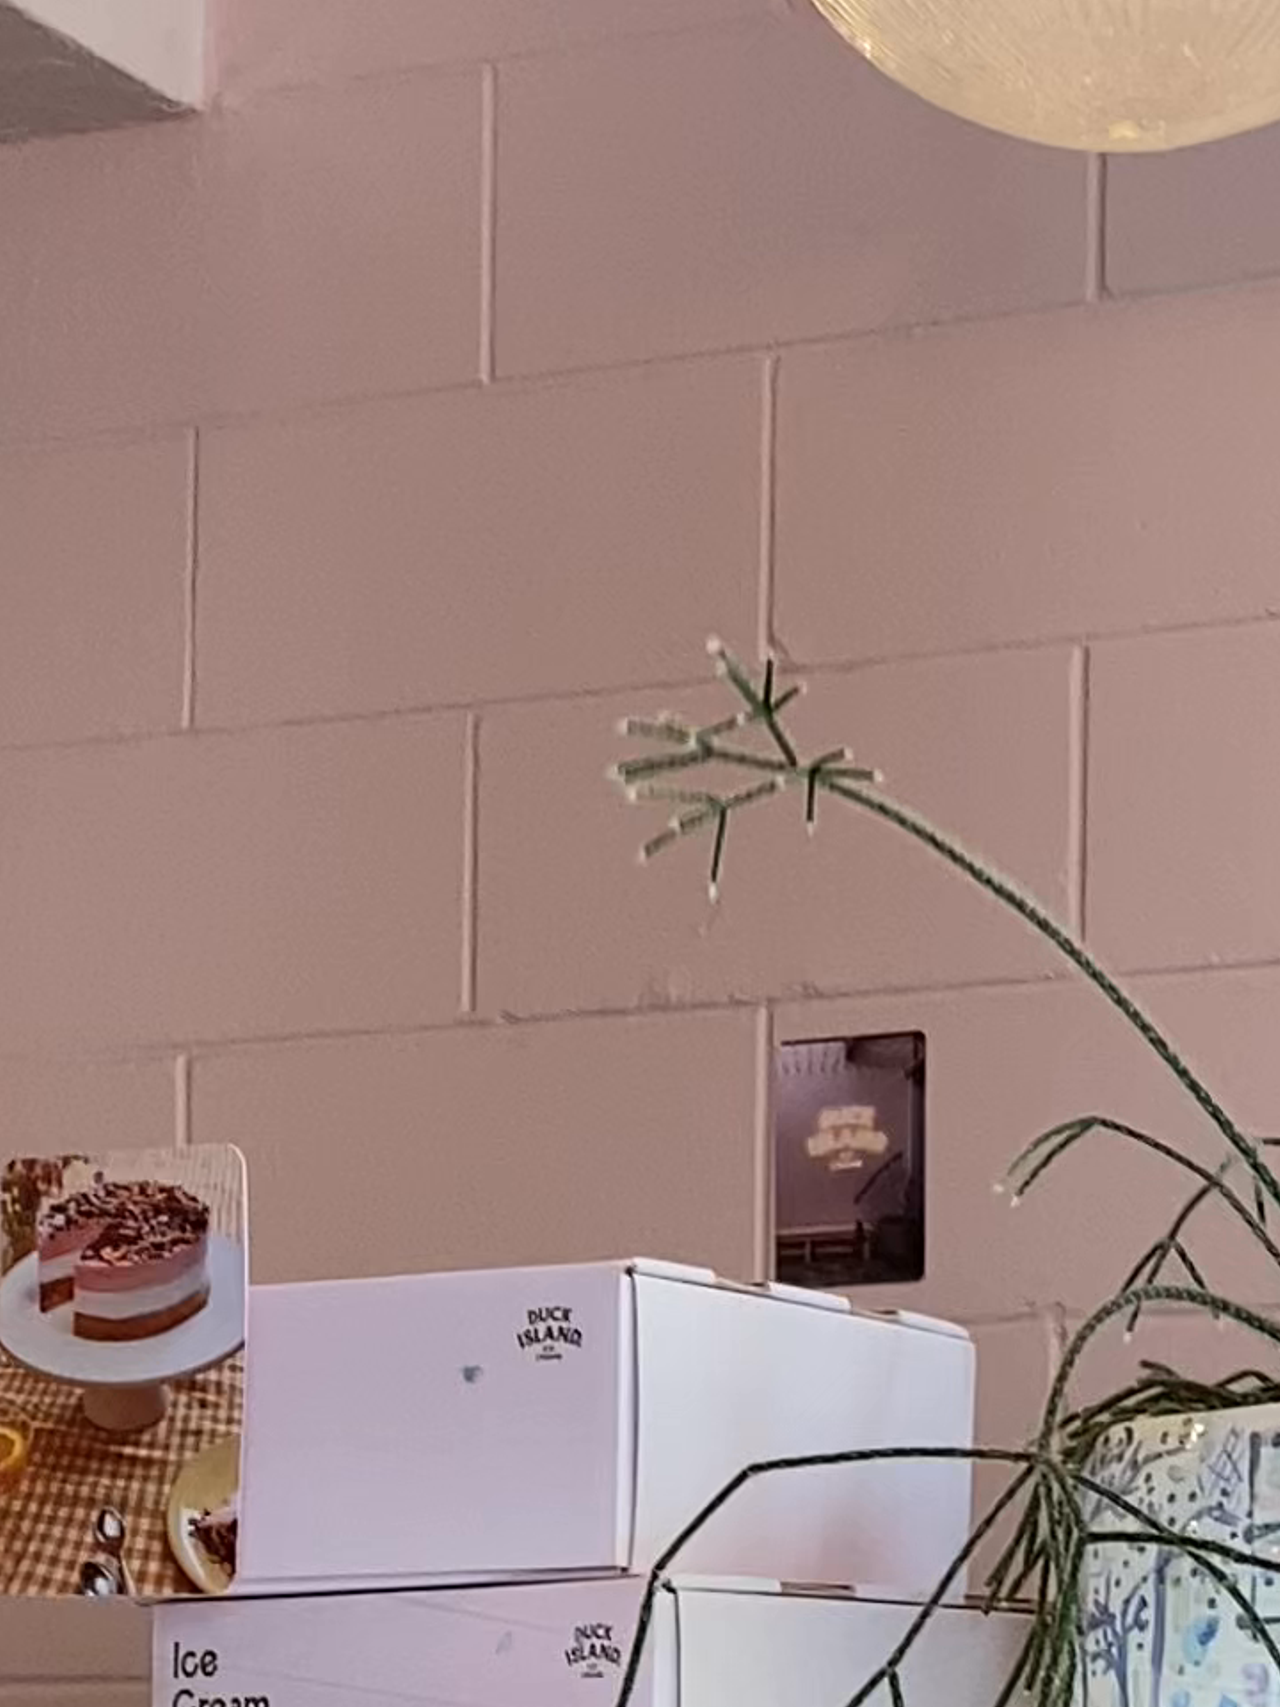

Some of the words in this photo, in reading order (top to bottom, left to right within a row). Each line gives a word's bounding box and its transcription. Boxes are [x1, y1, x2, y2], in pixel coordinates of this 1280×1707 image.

[527, 1306, 572, 1325] DUCK
[516, 1325, 583, 1350] ISLAND
[573, 1622, 613, 1644] DUCK
[173, 1641, 218, 1679] Ice
